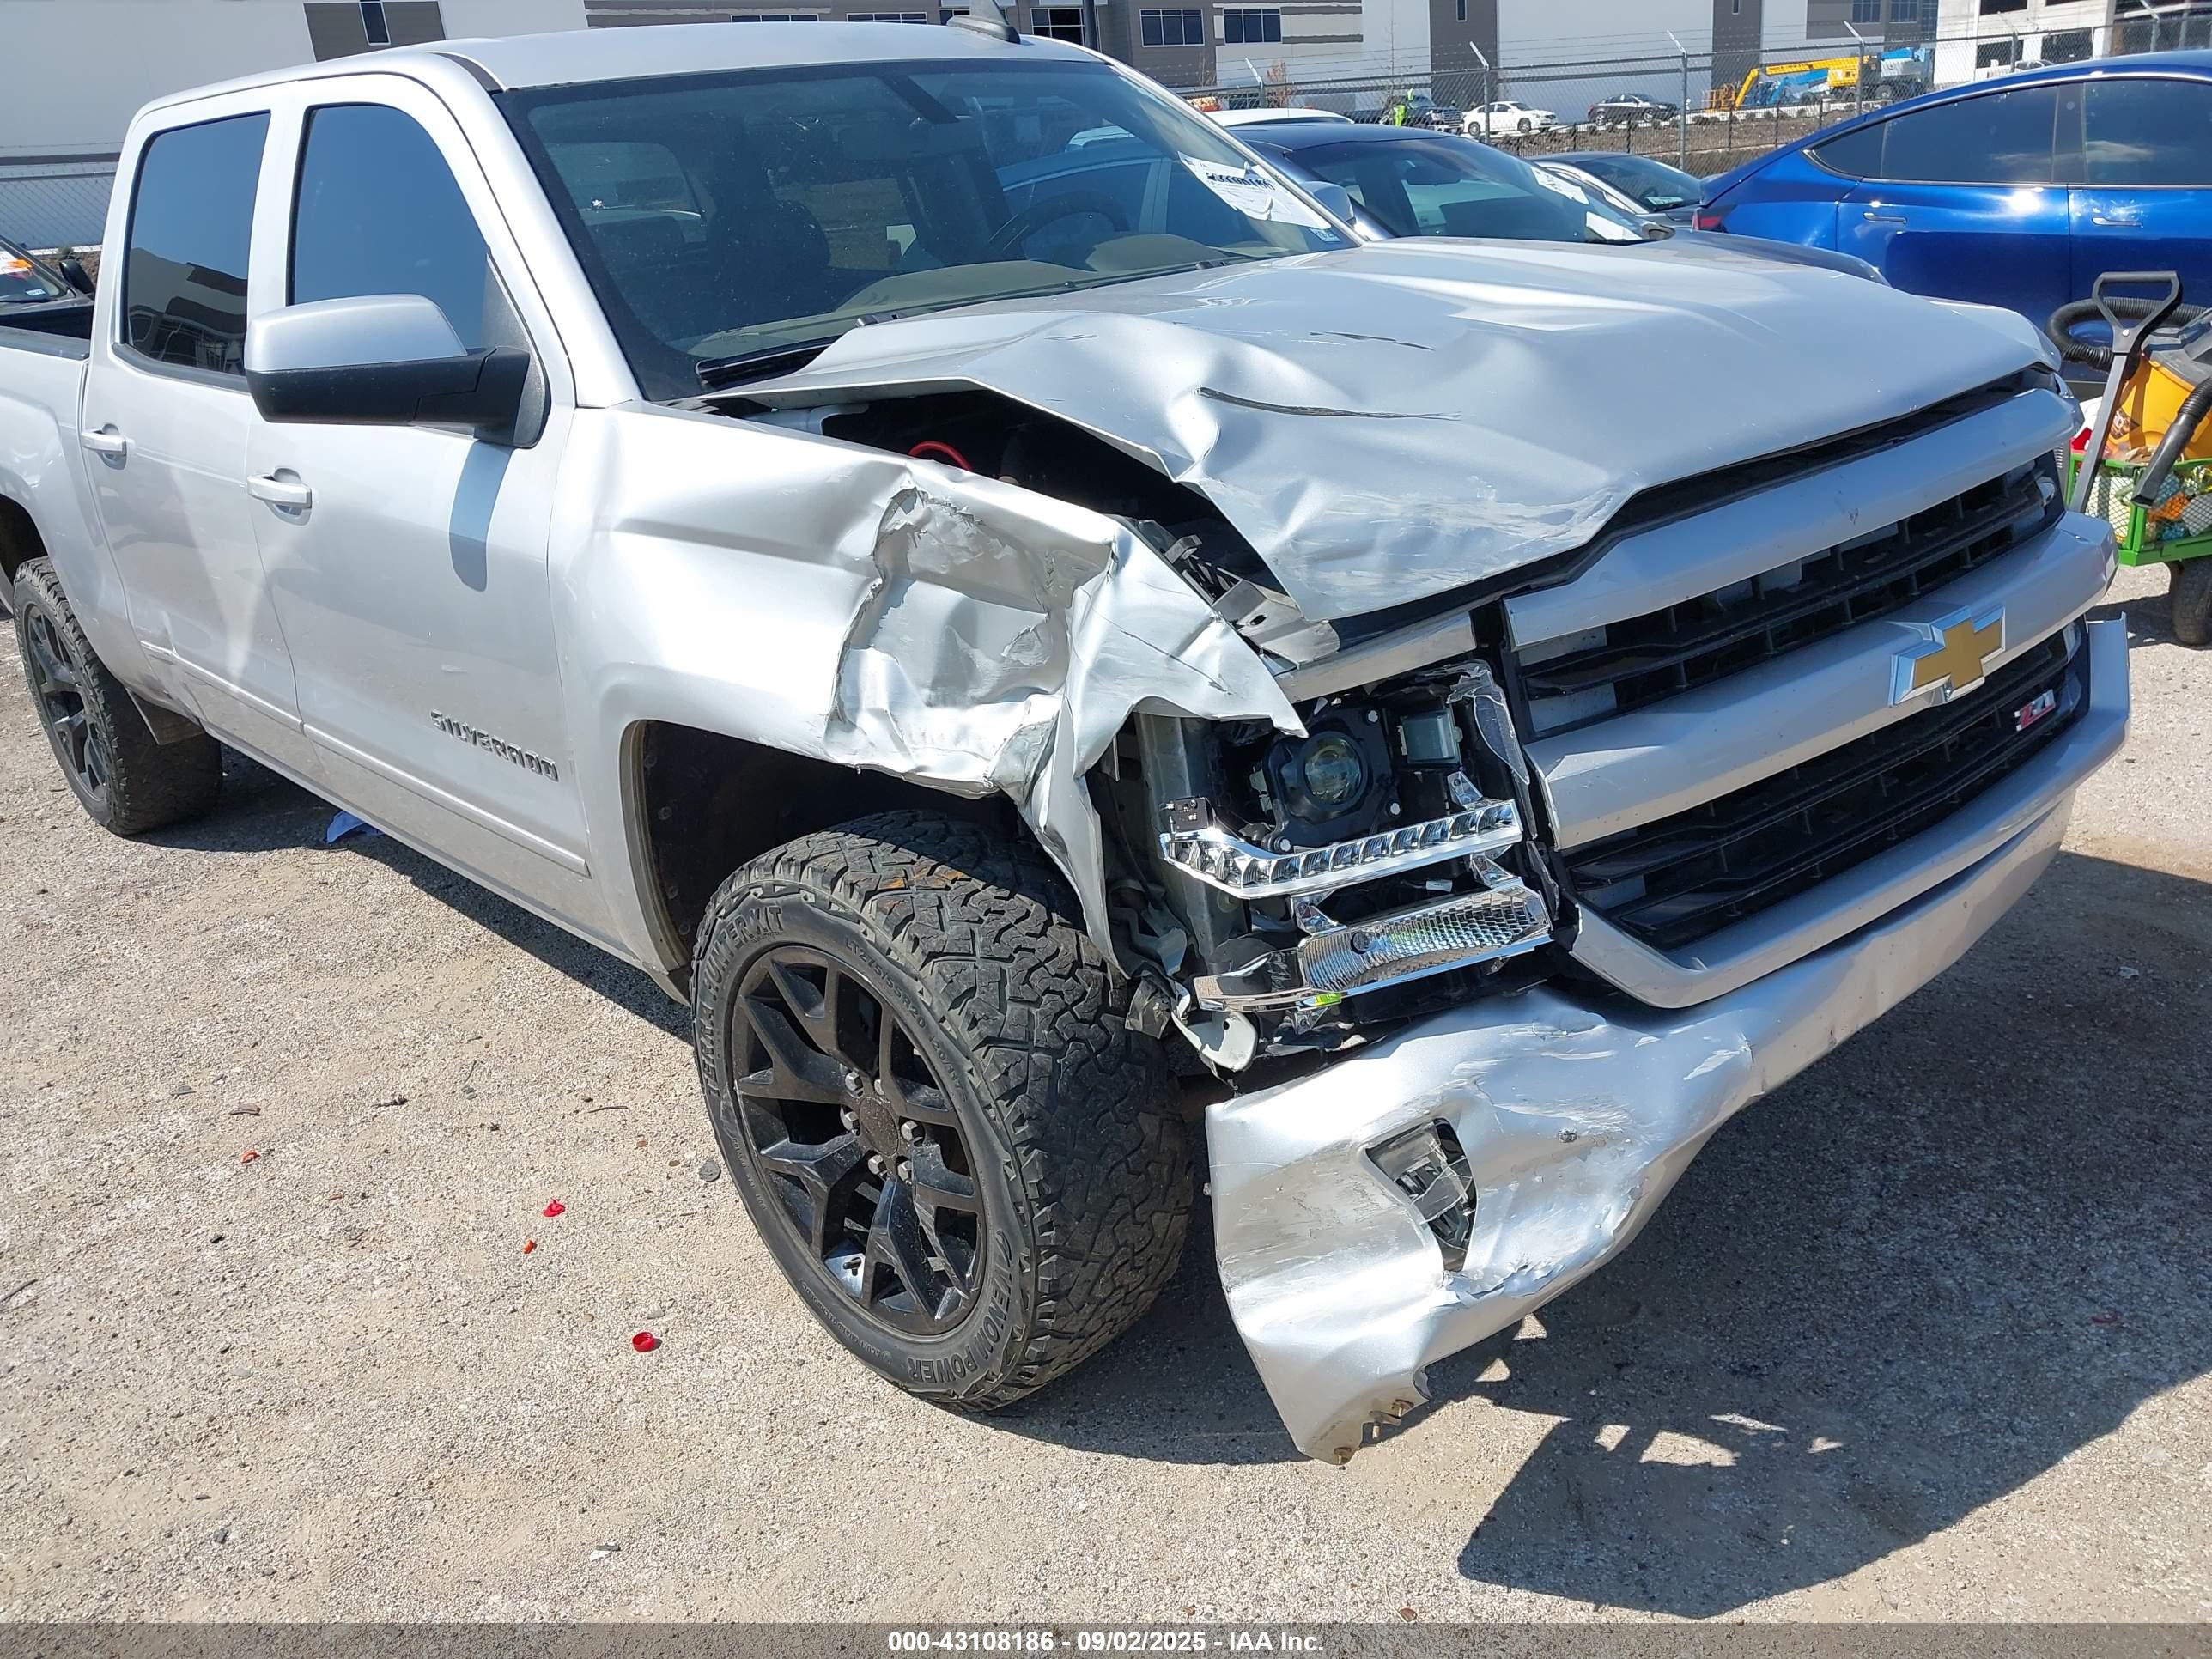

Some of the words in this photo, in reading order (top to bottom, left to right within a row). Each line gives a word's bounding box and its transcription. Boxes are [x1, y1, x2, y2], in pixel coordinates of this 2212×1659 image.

[430, 708, 559, 782] SILVERADO
[702, 915, 752, 1001] HUNTER
[844, 936, 927, 1030] LT275/55R20
[699, 1000, 720, 1097] TERRA
[973, 1265, 1012, 1360] VENOM
[907, 1344, 979, 1384] POWER
